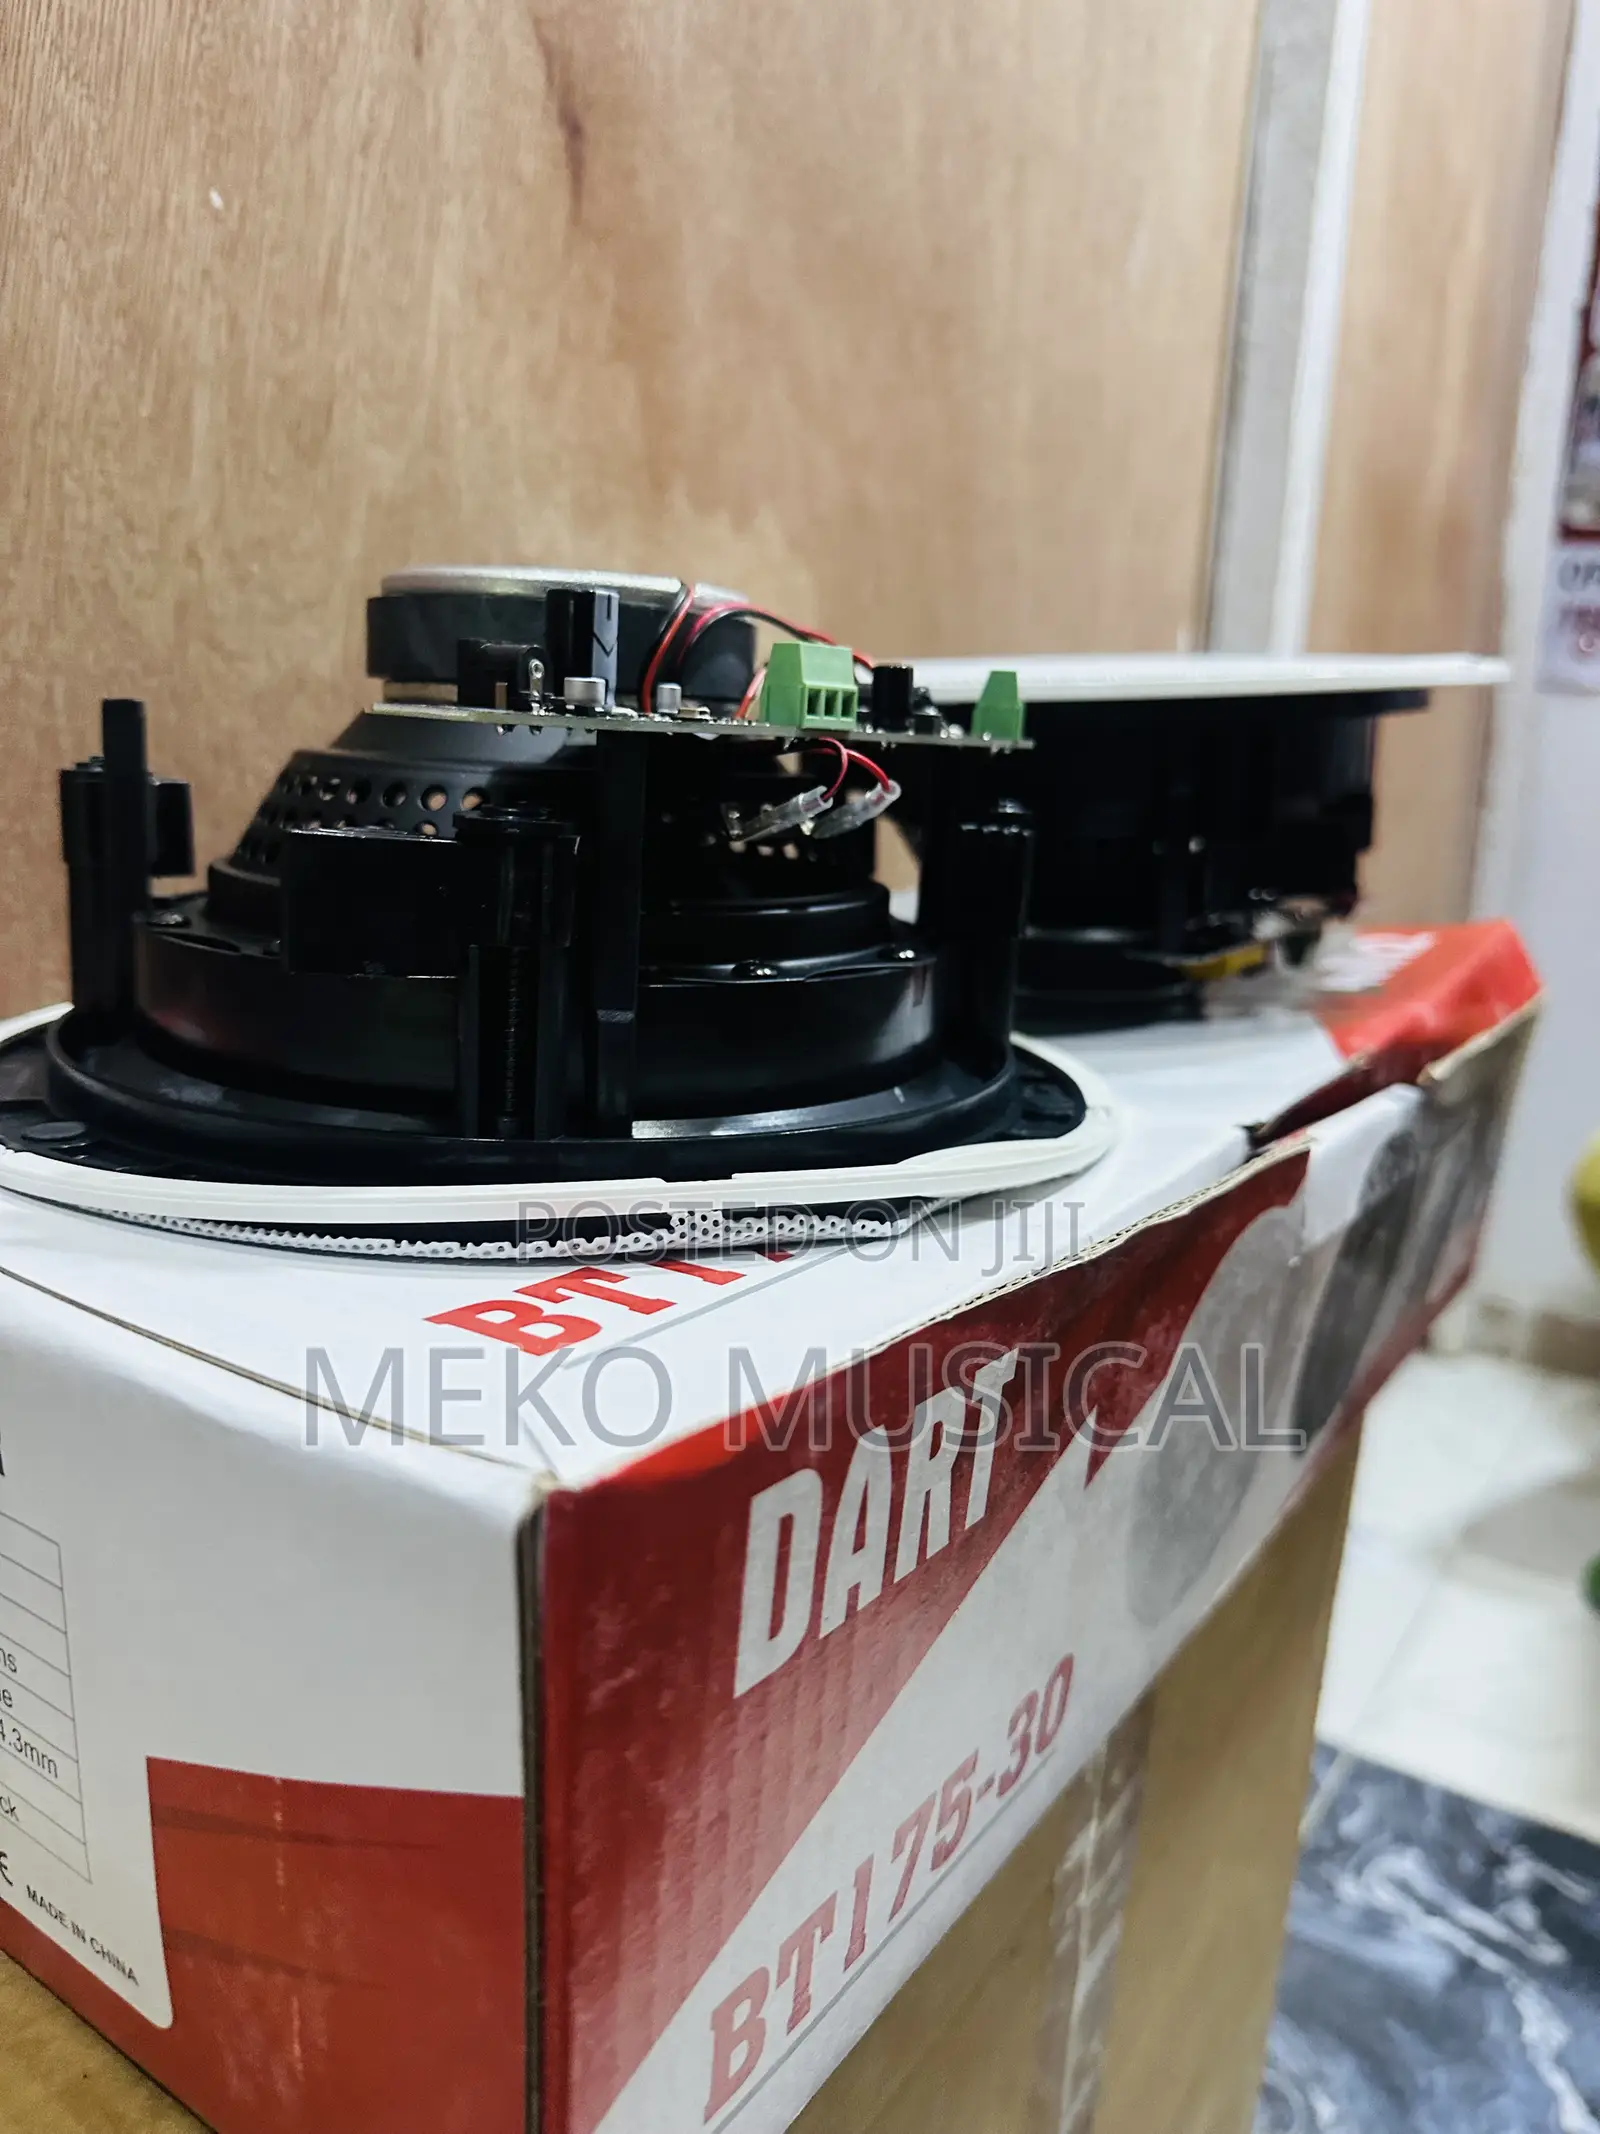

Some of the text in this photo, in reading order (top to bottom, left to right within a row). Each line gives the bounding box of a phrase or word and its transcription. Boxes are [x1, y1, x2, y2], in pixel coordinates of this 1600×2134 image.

[732, 1346, 1020, 1701] DART
[26, 1884, 140, 1988] MADE IN CHINA
